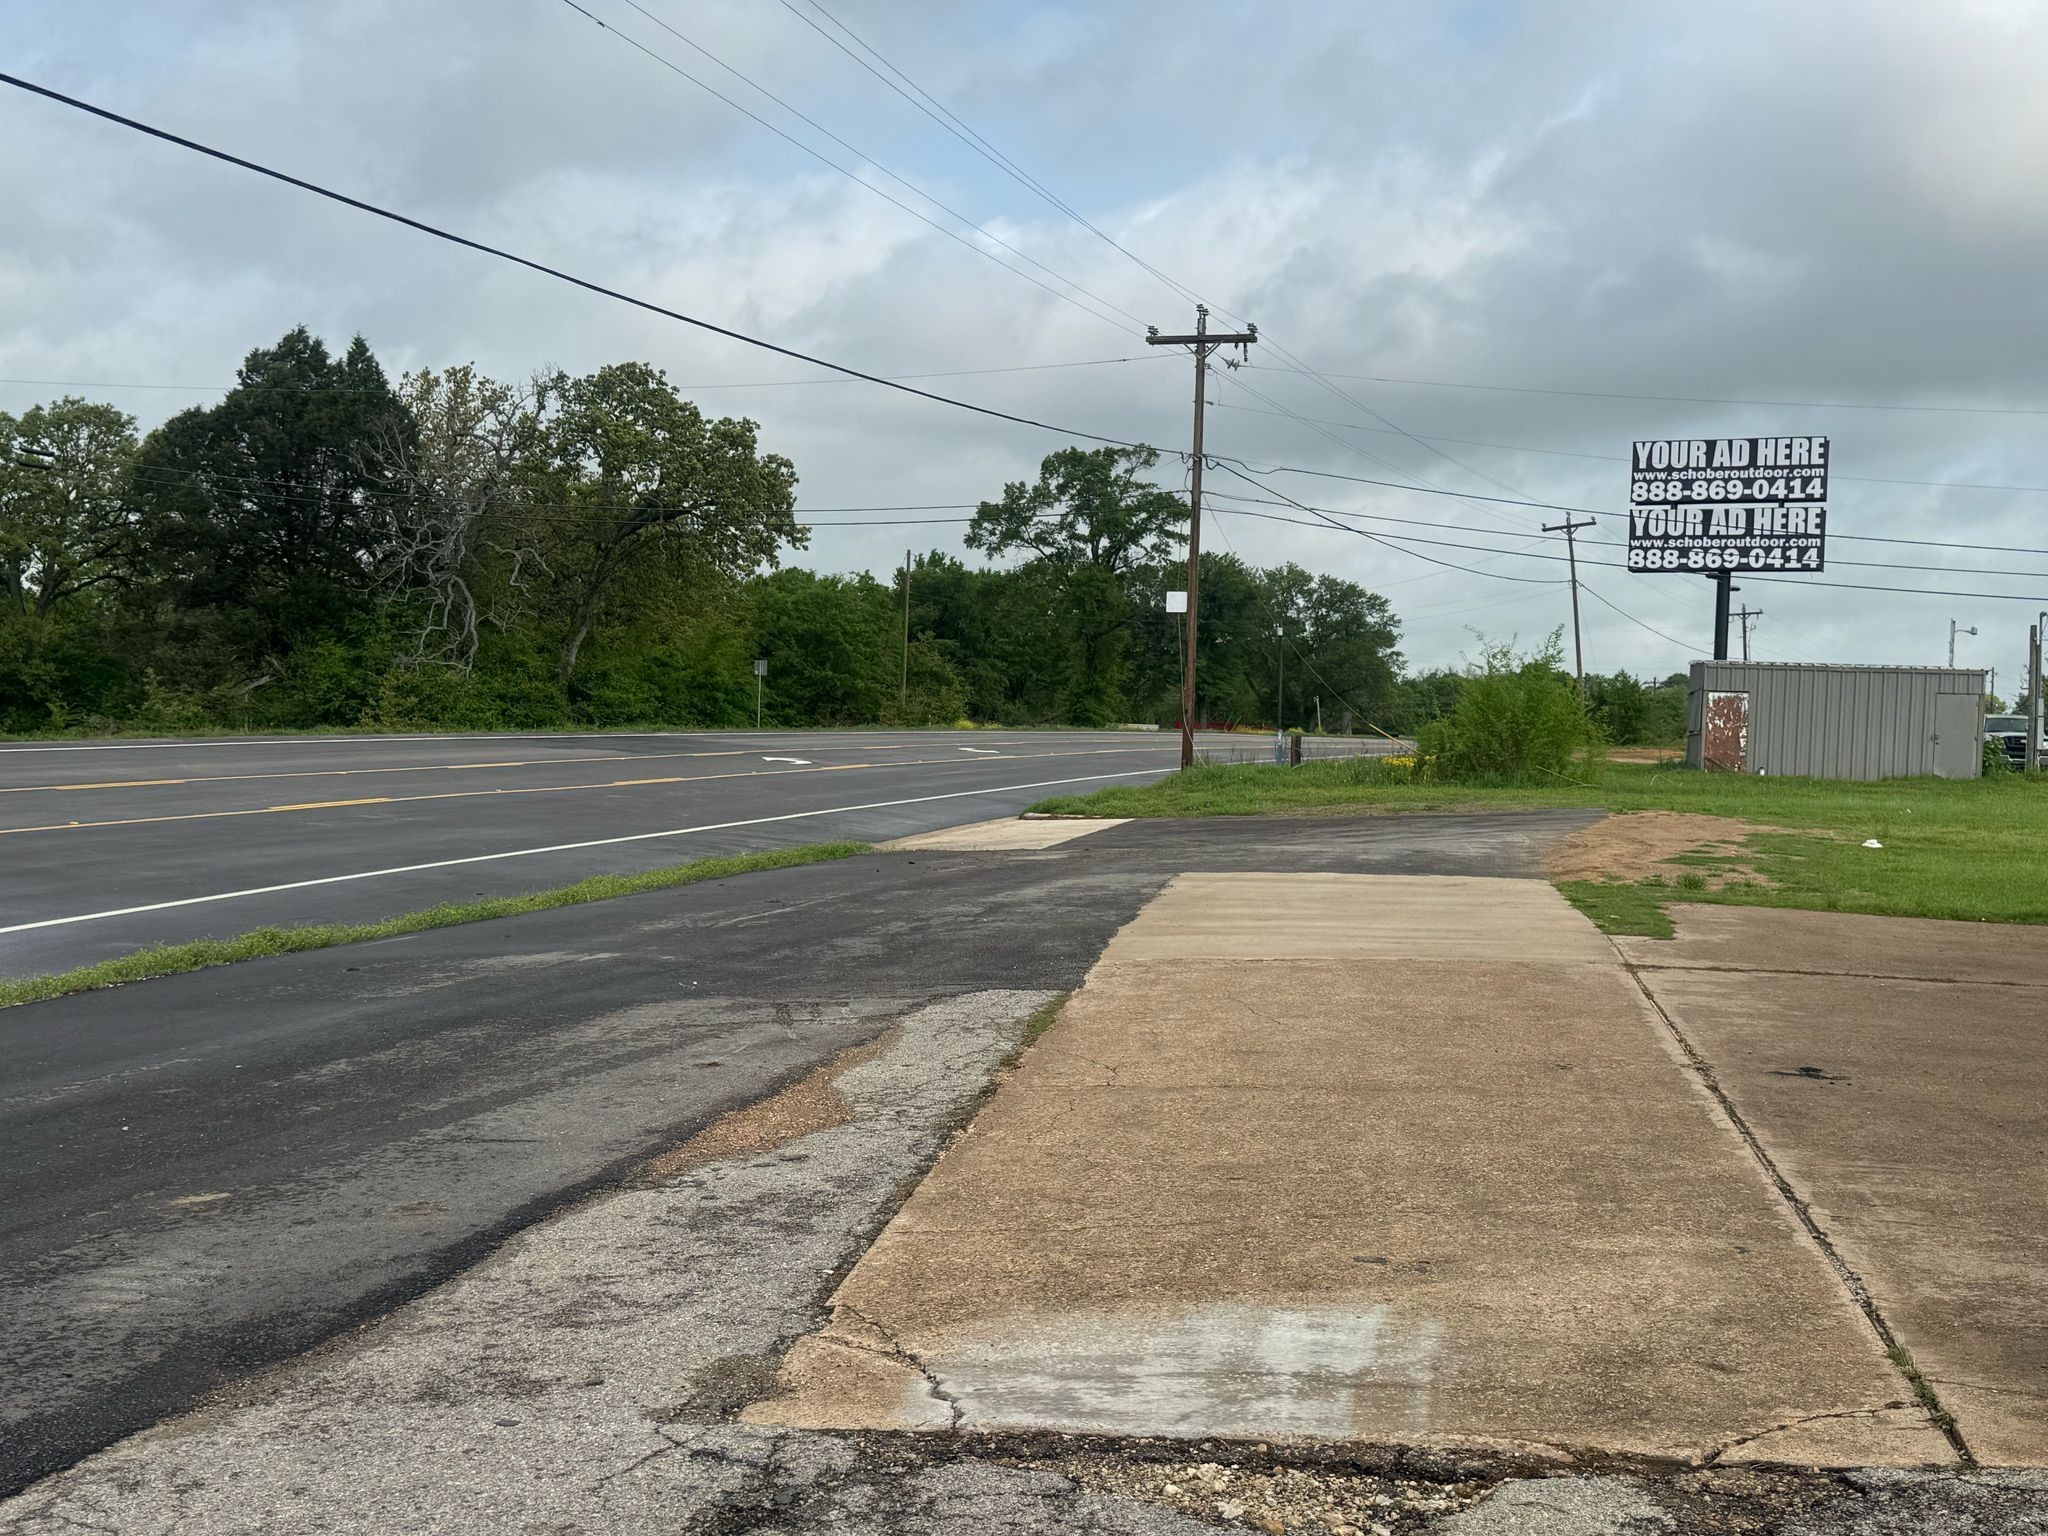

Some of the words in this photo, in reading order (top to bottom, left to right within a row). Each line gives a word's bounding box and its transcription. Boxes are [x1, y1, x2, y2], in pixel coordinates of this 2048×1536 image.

[1636, 441, 1707, 469] YOUR
[1712, 440, 1750, 467] AD
[1757, 437, 1825, 466] HERE
[1633, 467, 1825, 481] www.schoberoutdoor.com
[1631, 478, 1824, 501] 888-869-0414
[1632, 508, 1703, 537] YOUR
[1709, 508, 1746, 536] AD
[1753, 507, 1821, 535] HERE
[1630, 536, 1821, 548] www.schoberoutdoor.com
[1628, 548, 1820, 569] 888-869-0414
